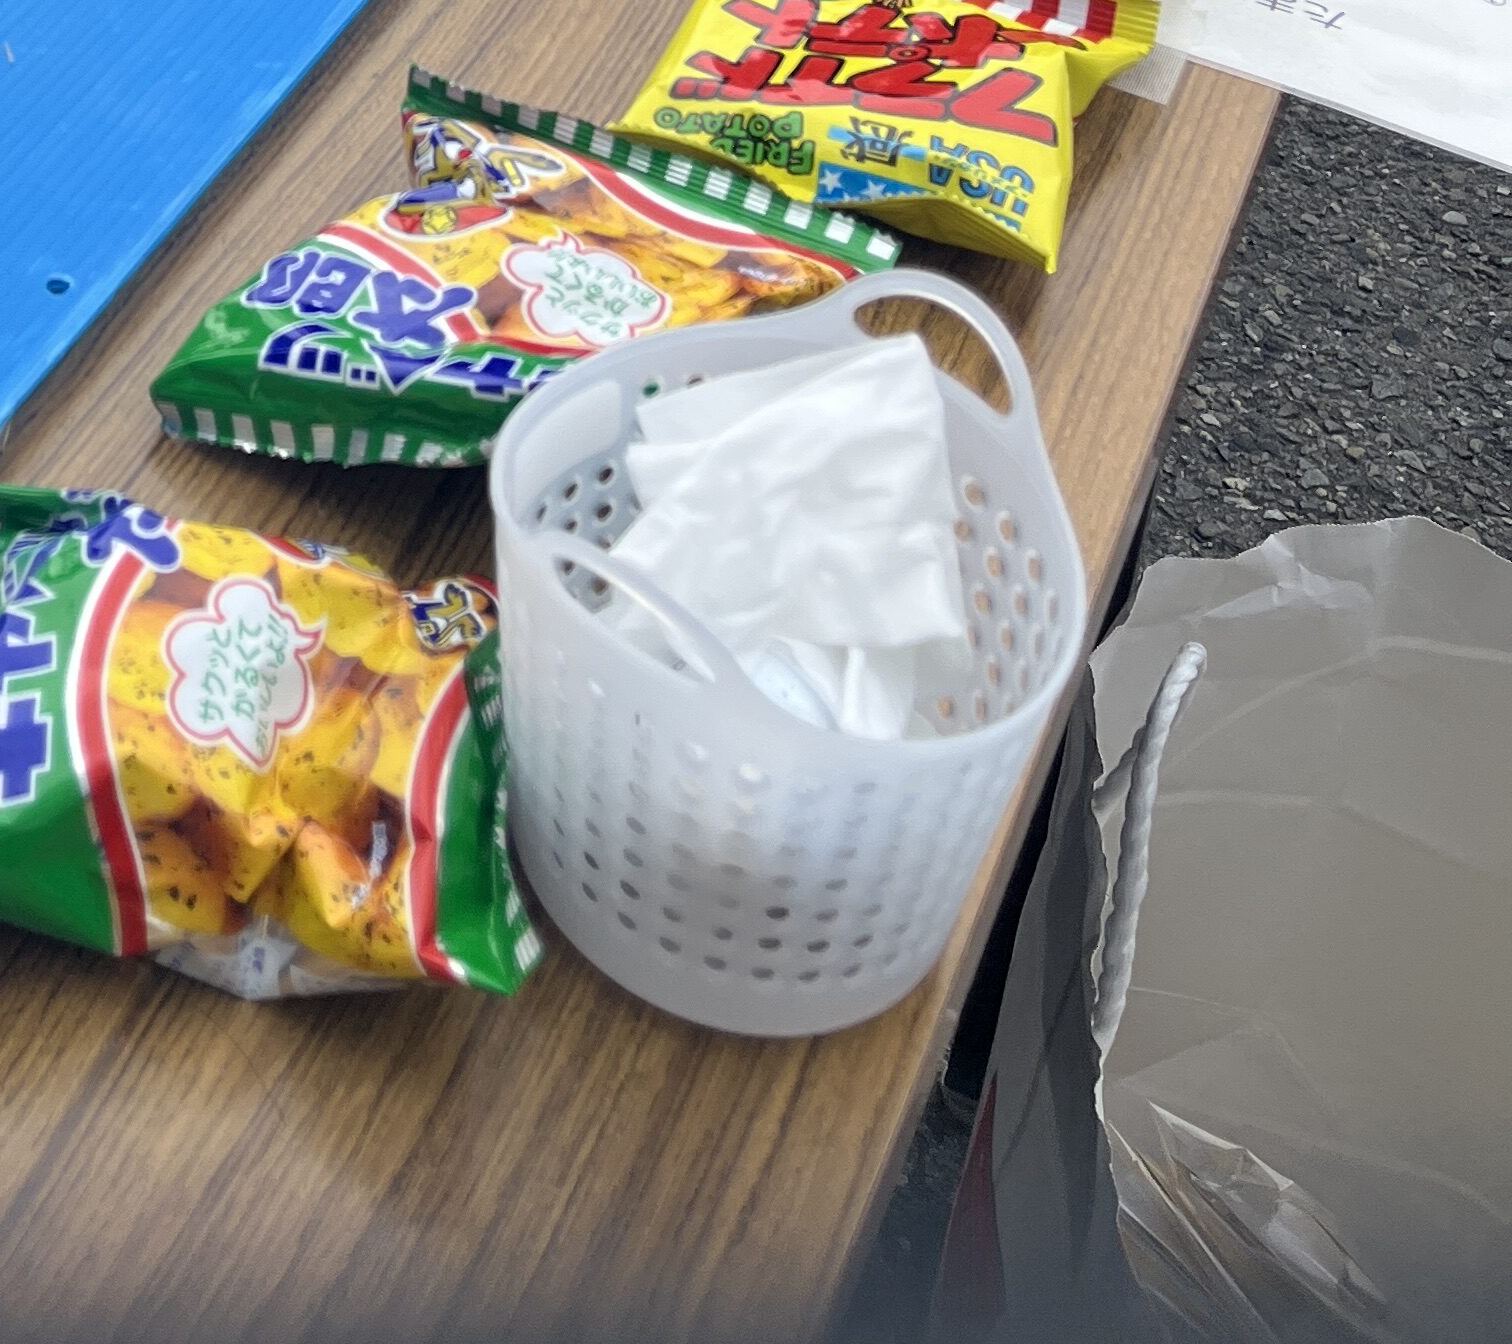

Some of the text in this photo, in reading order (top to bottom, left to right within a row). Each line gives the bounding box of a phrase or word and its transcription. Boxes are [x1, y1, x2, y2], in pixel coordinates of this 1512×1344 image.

[654, 106, 805, 140] POTATO
[669, 47, 1060, 148] フライド
[840, 115, 916, 166] 感
[928, 132, 1037, 219] USA
[242, 248, 478, 352] 太郎
[198, 625, 233, 725] サクッと
